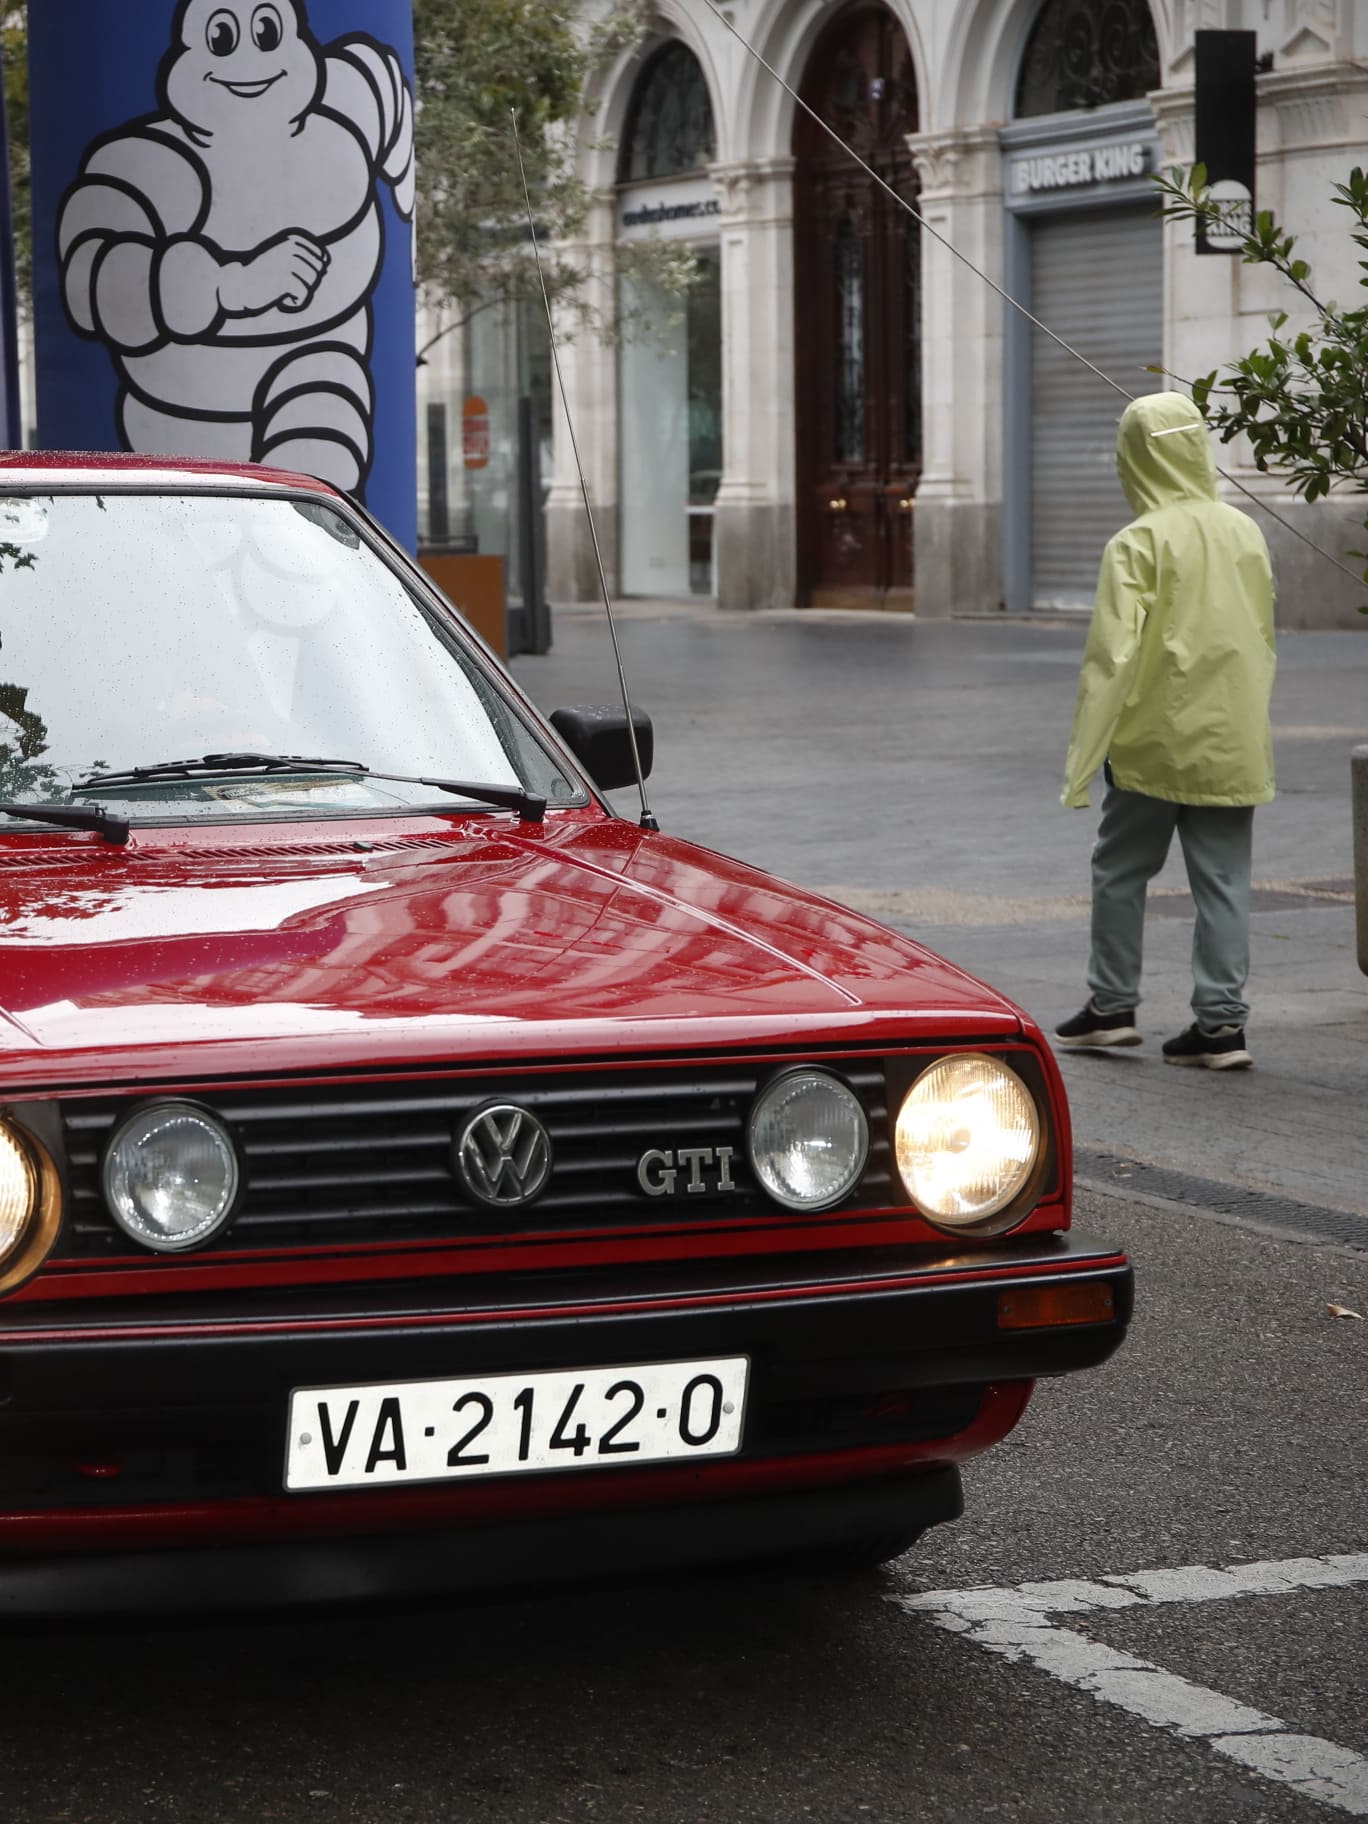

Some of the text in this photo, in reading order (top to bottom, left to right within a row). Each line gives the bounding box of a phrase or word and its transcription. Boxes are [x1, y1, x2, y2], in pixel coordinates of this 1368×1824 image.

[1016, 143, 1145, 192] BURGER KING
[637, 1146, 735, 1196] GTI
